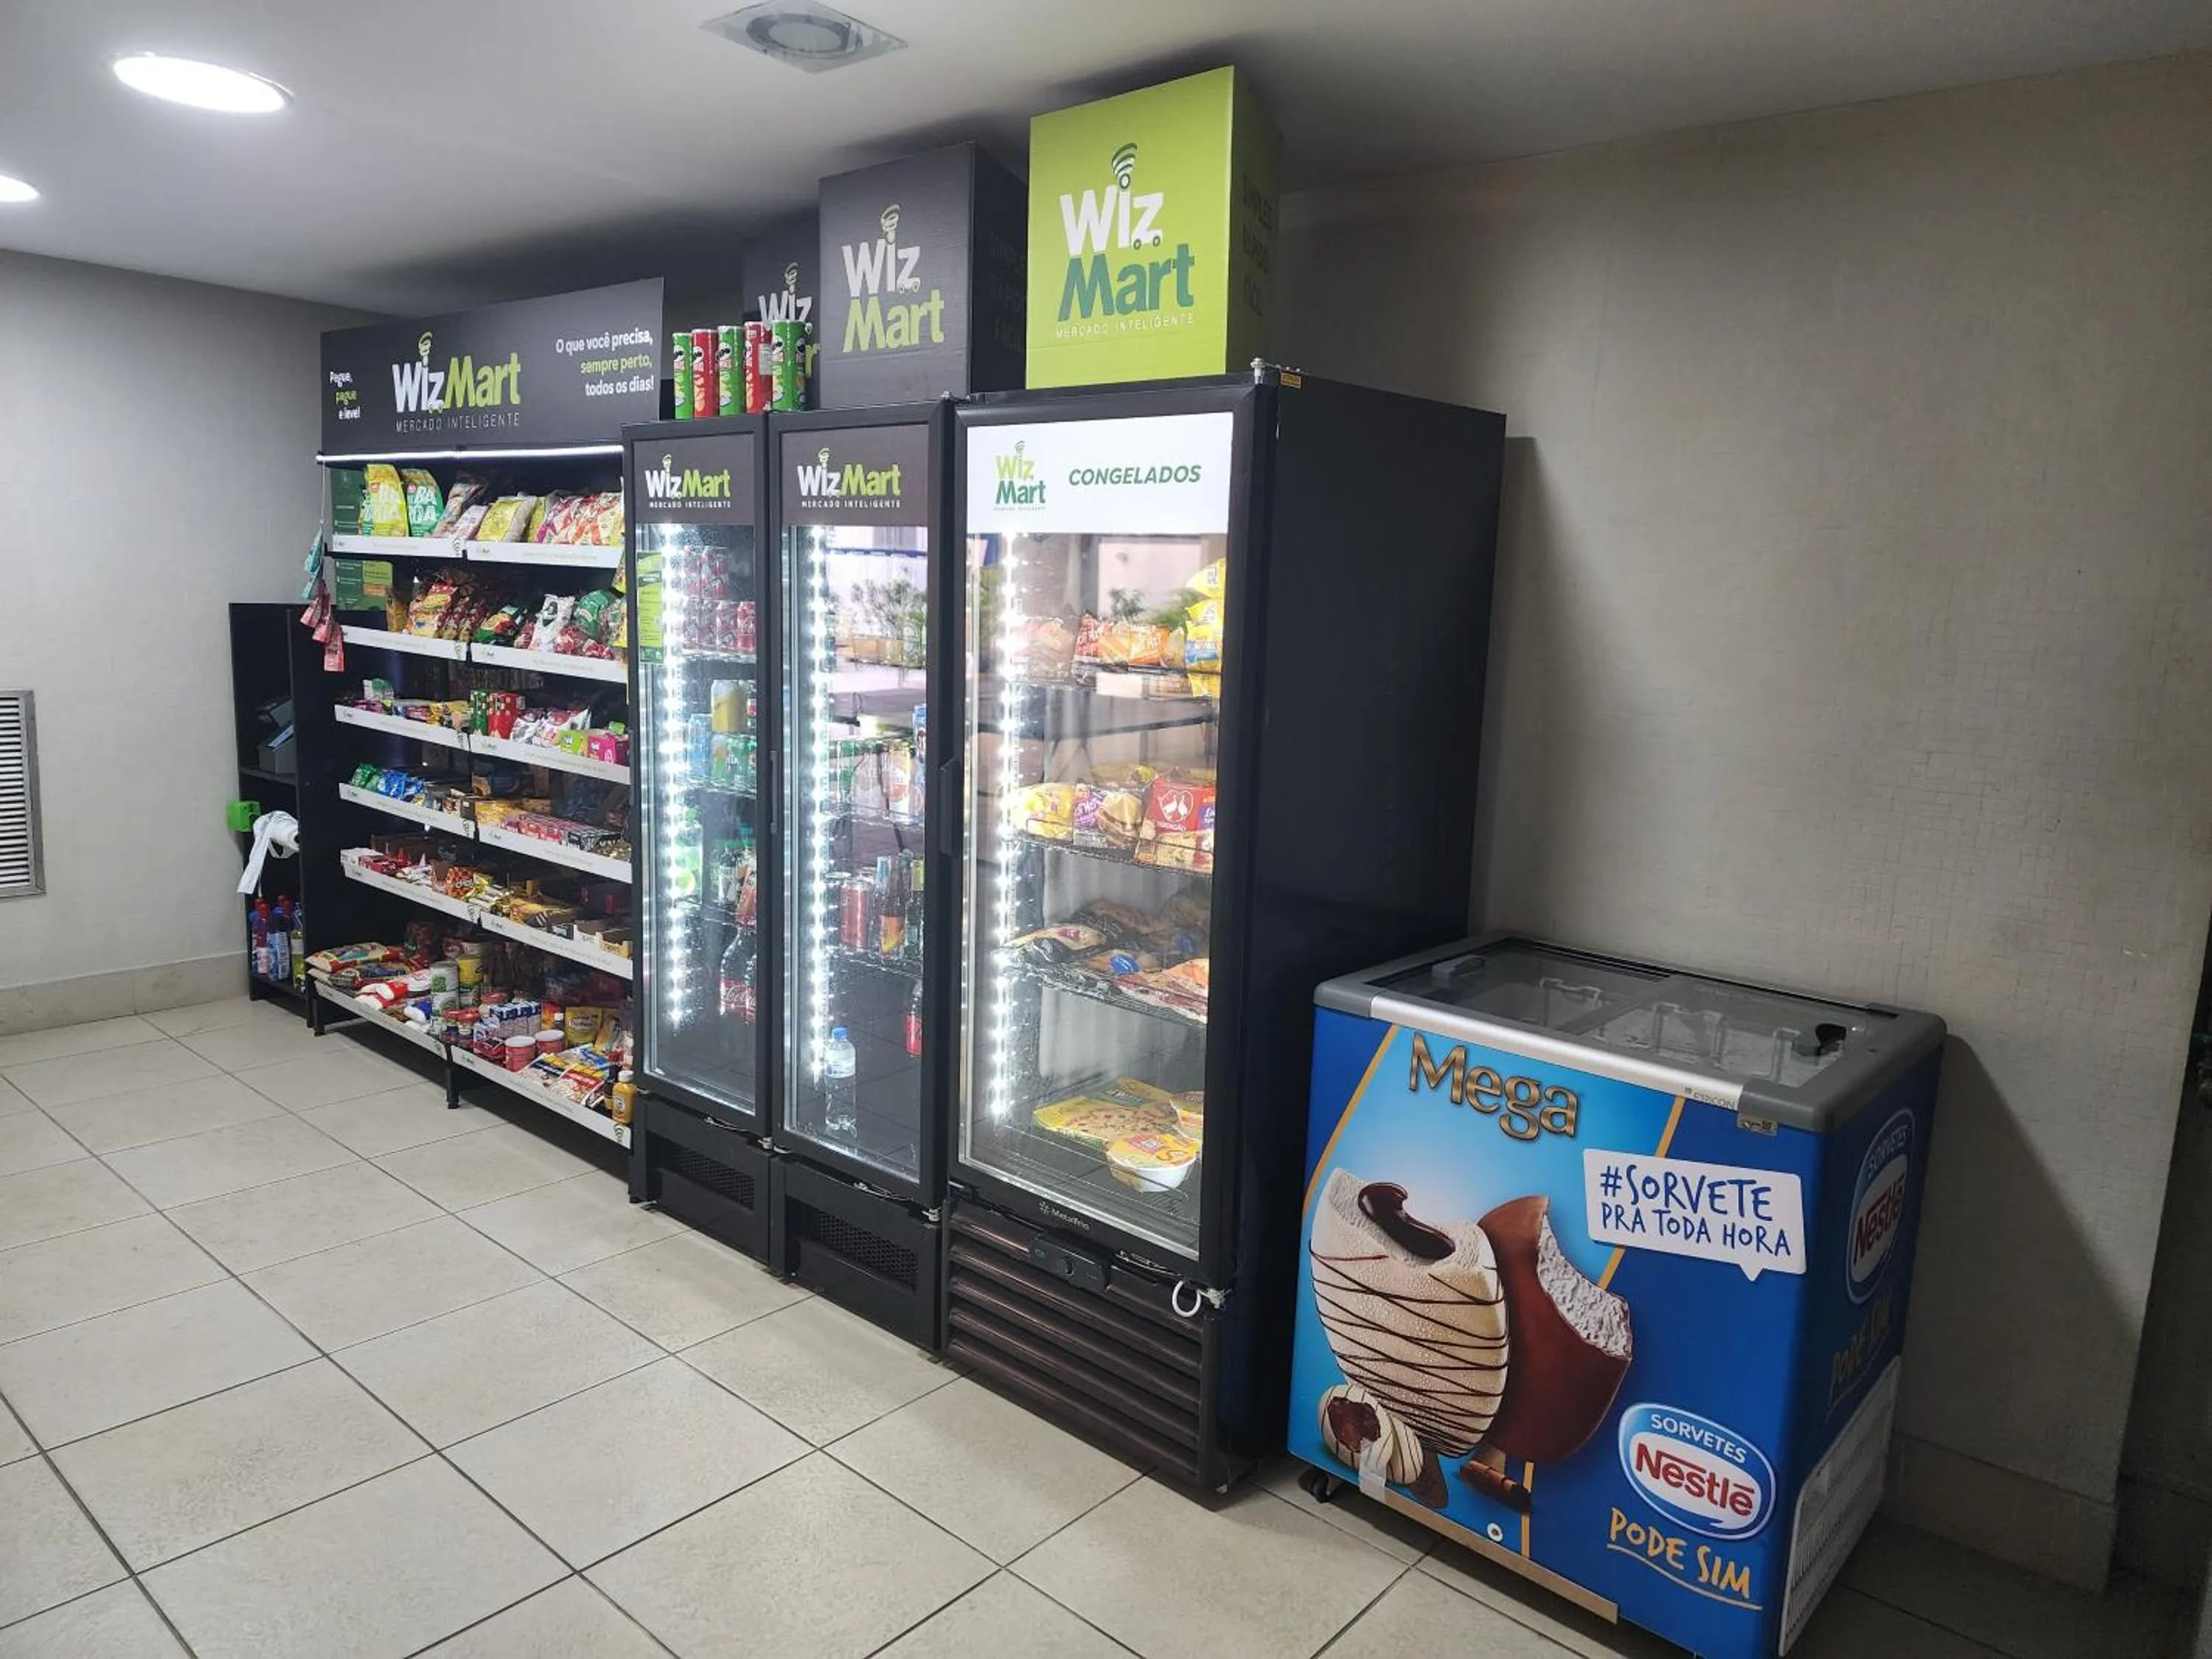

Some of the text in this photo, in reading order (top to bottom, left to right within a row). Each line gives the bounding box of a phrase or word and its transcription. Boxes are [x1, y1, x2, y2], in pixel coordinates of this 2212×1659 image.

[1060, 173, 1164, 257] Wiz
[842, 230, 921, 298] Wiz
[1057, 243, 1195, 322] Mart
[555, 327, 653, 356] O que você precisa,
[842, 289, 945, 353] Mart
[1056, 314, 1194, 339] MERCADO INTELIGENTE
[392, 349, 521, 414] WizMart
[580, 358, 619, 376] sempre
[620, 353, 653, 374] perto,
[585, 374, 655, 397] todos os dias!
[395, 412, 521, 434] MERCADO INTELIGENTE
[644, 465, 731, 499] WizMart
[797, 459, 901, 498] WizMart
[995, 453, 1035, 481] Wiz
[1068, 465, 1202, 487] CONGELADOS
[801, 499, 901, 508] MERCADO INTELIGENTE
[995, 479, 1046, 505] Mart
[1408, 1032, 1579, 1141] Mega
[1599, 1164, 1773, 1222] #SORVETE
[1601, 1202, 1792, 1257] PRA TODA HORA
[1650, 1413, 1748, 1464] SORVETES
[1635, 1442, 1756, 1517] Nestlé
[1608, 1507, 1751, 1600] PODE SIM
